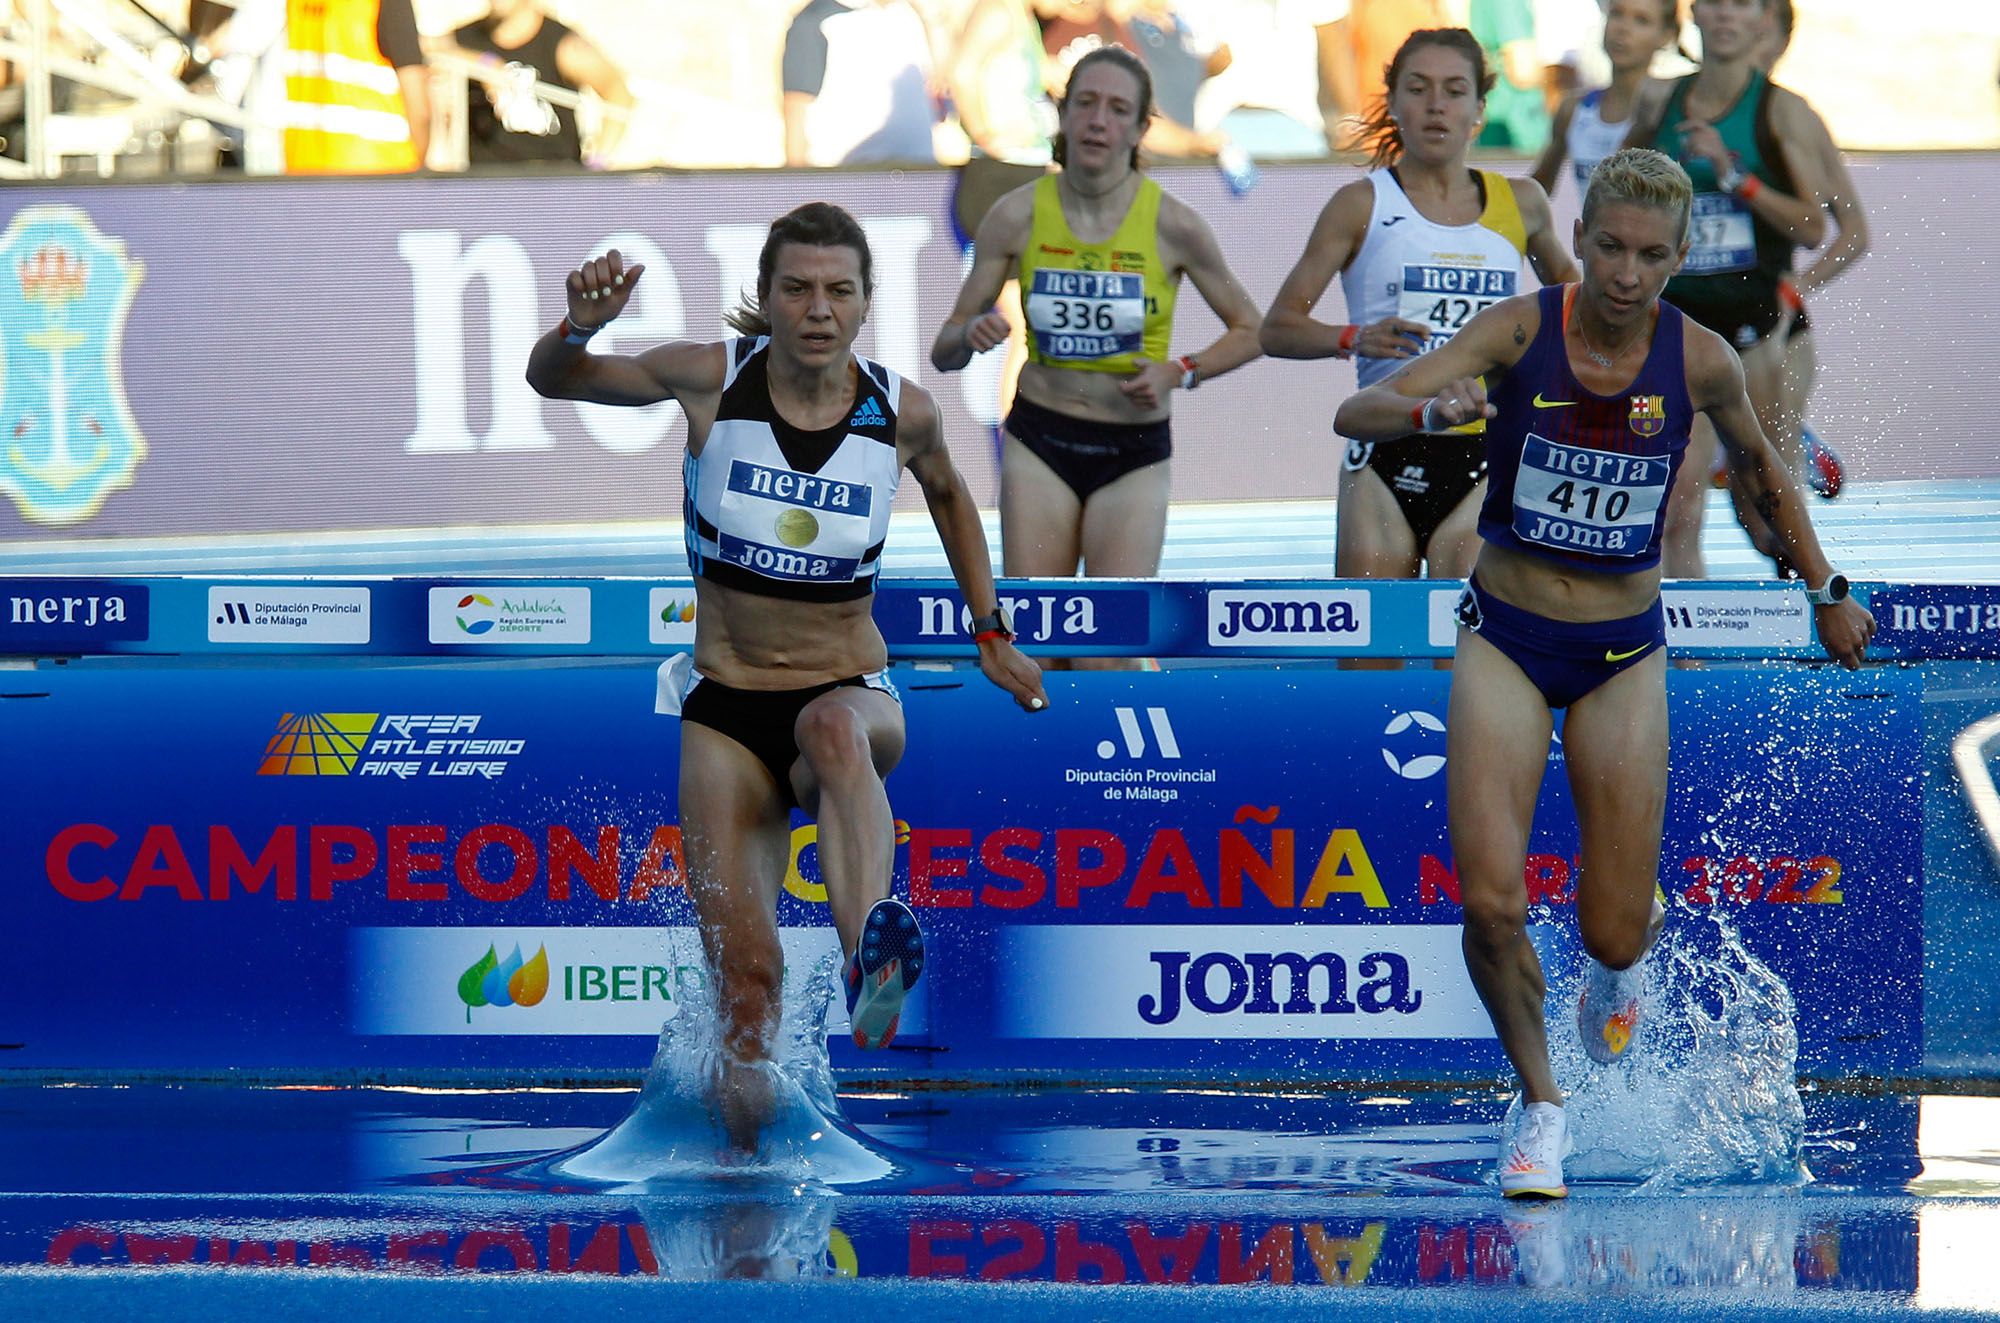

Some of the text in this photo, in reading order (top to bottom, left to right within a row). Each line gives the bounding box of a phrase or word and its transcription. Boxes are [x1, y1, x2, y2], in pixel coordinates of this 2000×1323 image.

[1045, 272, 1124, 298] nerja
[1421, 268, 1505, 294] nerja
[1051, 301, 1114, 331] 336
[850, 414, 887, 427] adidas
[1544, 446, 1649, 484] nerja
[749, 467, 851, 508] nerja
[1546, 480, 1631, 522] 410
[10, 597, 127, 627] nerja
[255, 603, 361, 614] Diputación Provincial
[255, 615, 308, 627] de Málaga
[1892, 604, 2000, 635] nerja
[378, 715, 482, 738] RFEA
[369, 740, 526, 755] ATLETISMO
[359, 761, 508, 779] AIRE LIBRE
[1065, 768, 1216, 785] Diputación Provincial
[1104, 786, 1178, 803] de Málaga
[45, 822, 829, 902] CAMPEONA
[909, 804, 1390, 909] ESPAÑA
[1681, 855, 1843, 904] 2022
